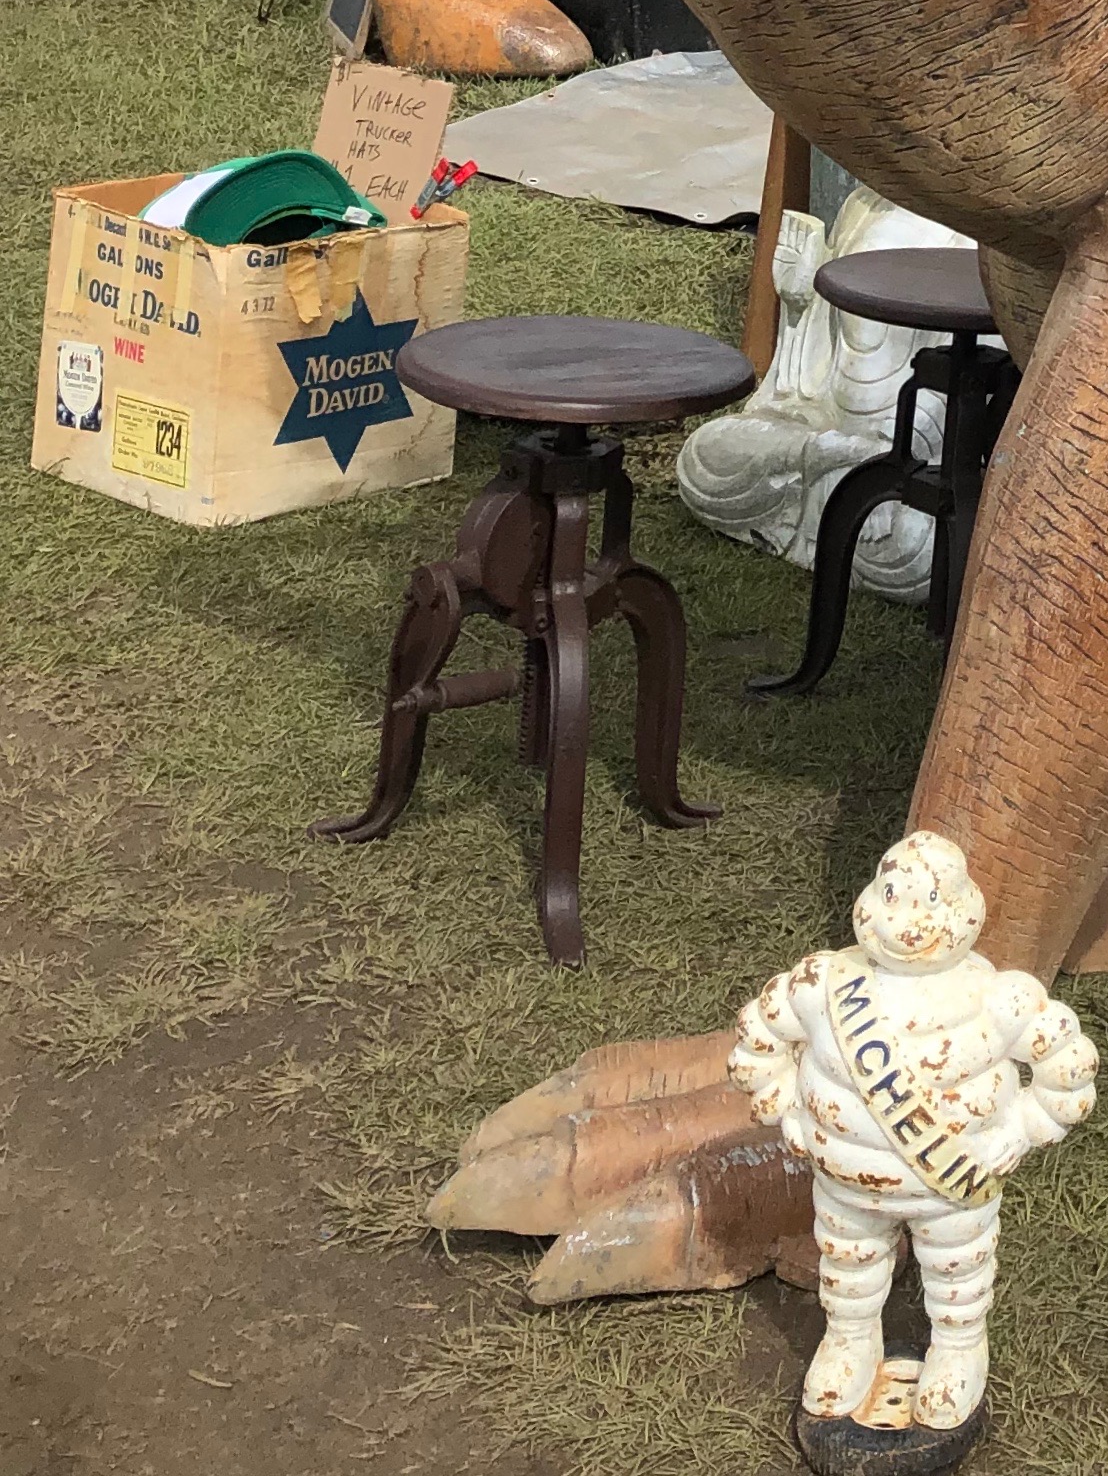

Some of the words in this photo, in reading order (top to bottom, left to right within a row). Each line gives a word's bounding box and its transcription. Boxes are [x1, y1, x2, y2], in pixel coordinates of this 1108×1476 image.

[347, 141, 381, 162] HATS
[365, 175, 409, 201] EACH
[97, 242, 164, 280] GALONS
[114, 336, 146, 364] WINE
[301, 349, 395, 387] MOGEN
[306, 382, 385, 418] DAVID
[155, 419, 182, 460] 1234
[834, 974, 990, 1200] MICHELIN
